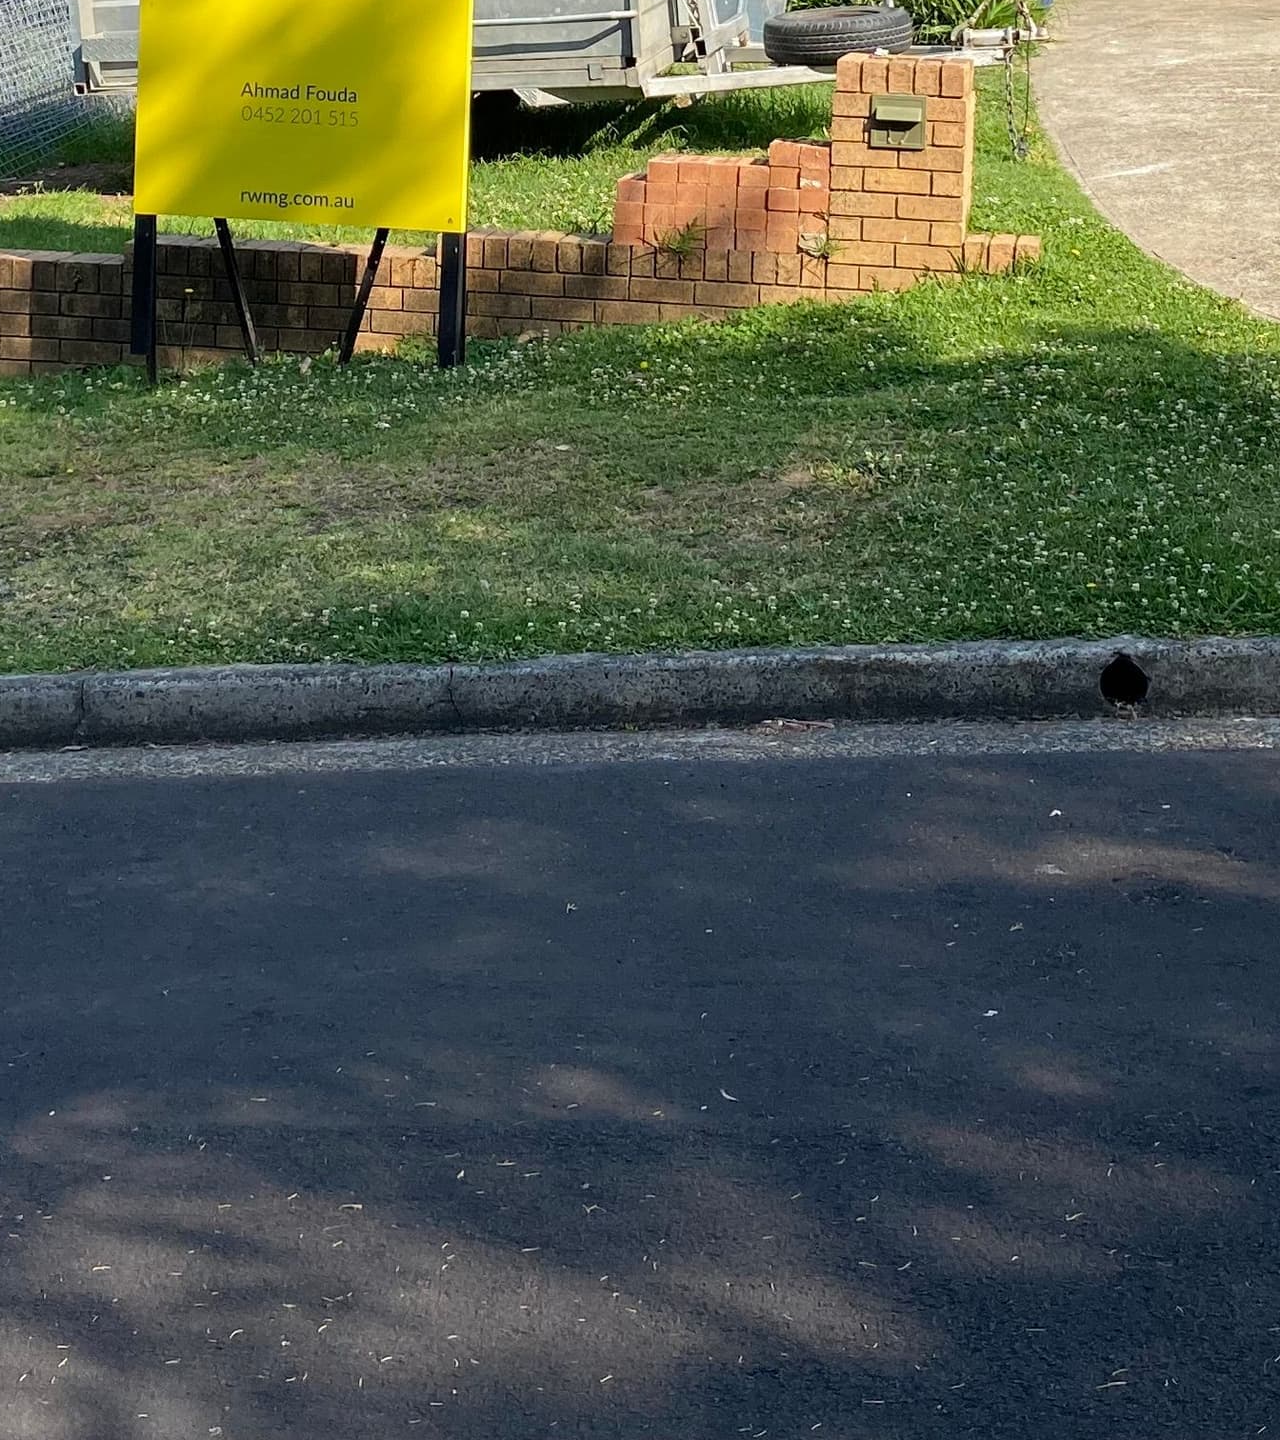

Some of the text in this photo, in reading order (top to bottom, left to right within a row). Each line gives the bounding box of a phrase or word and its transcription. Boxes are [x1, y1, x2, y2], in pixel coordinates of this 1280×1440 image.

[240, 82, 357, 103] Ahmad Fouda
[241, 105, 359, 127] 0452 201 515
[240, 190, 355, 209] rwmg.com.au
